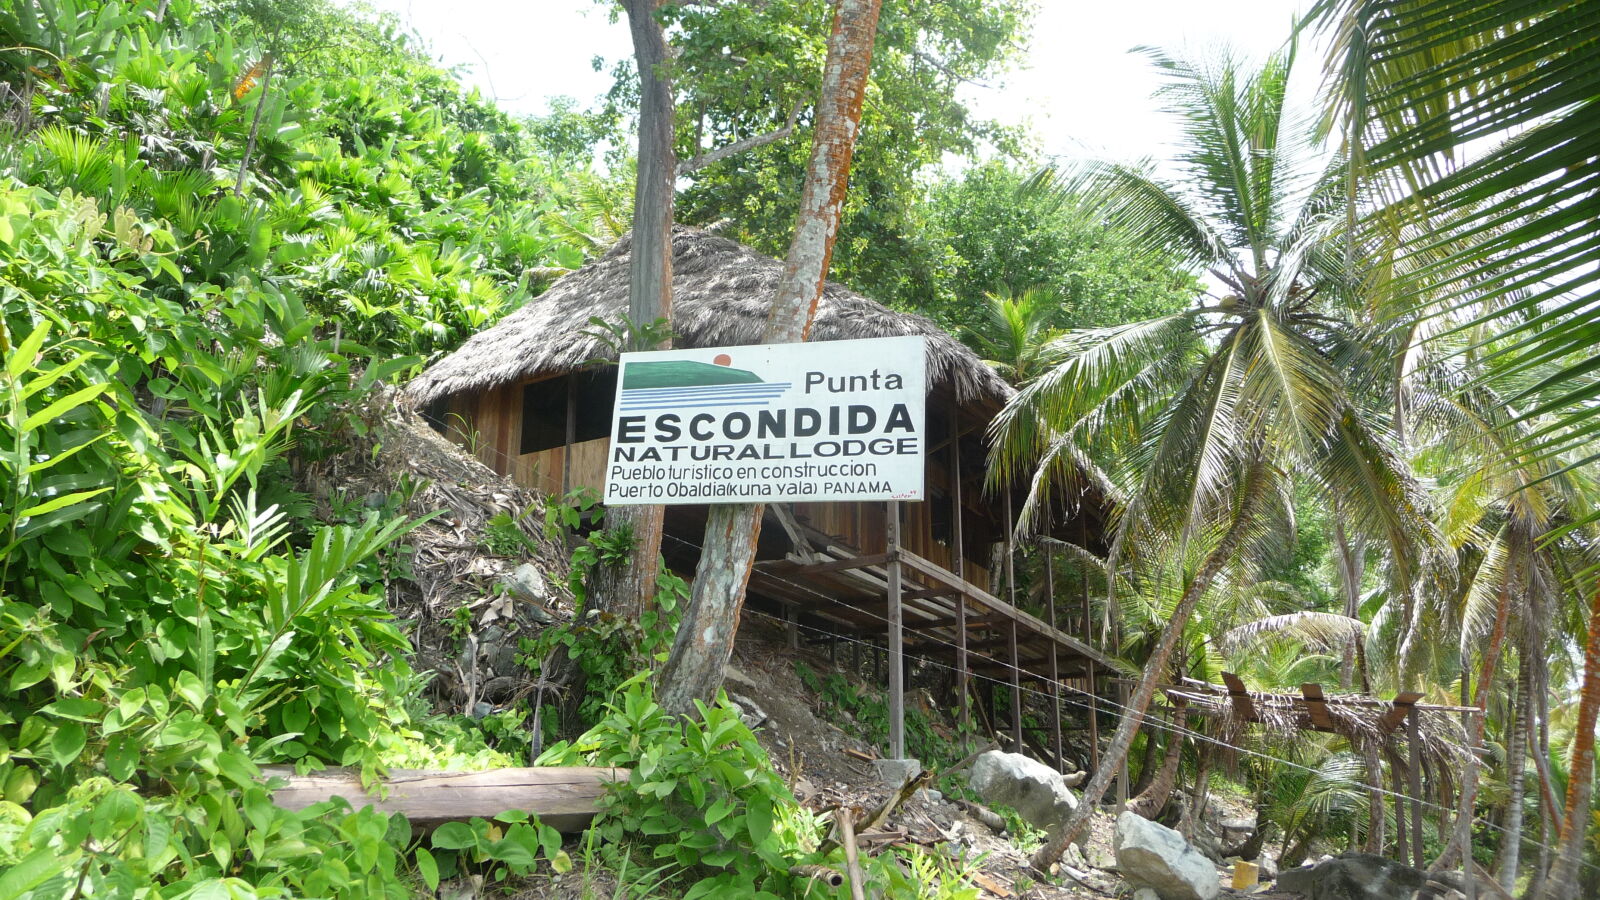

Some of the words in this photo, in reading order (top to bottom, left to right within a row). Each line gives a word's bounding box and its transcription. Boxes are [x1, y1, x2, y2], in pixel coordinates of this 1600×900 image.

[805, 368, 903, 394] Punta
[617, 403, 915, 443] ESCONDIDA
[614, 443, 785, 462] NATURAL
[790, 437, 918, 457] LODGE
[611, 465, 666, 480] Pueblo
[668, 464, 733, 480] turistico
[736, 467, 757, 479] en
[761, 459, 877, 479] construccion
[608, 482, 664, 498] Puerto
[776, 481, 818, 496] yala)
[823, 481, 893, 495] PANAMA
